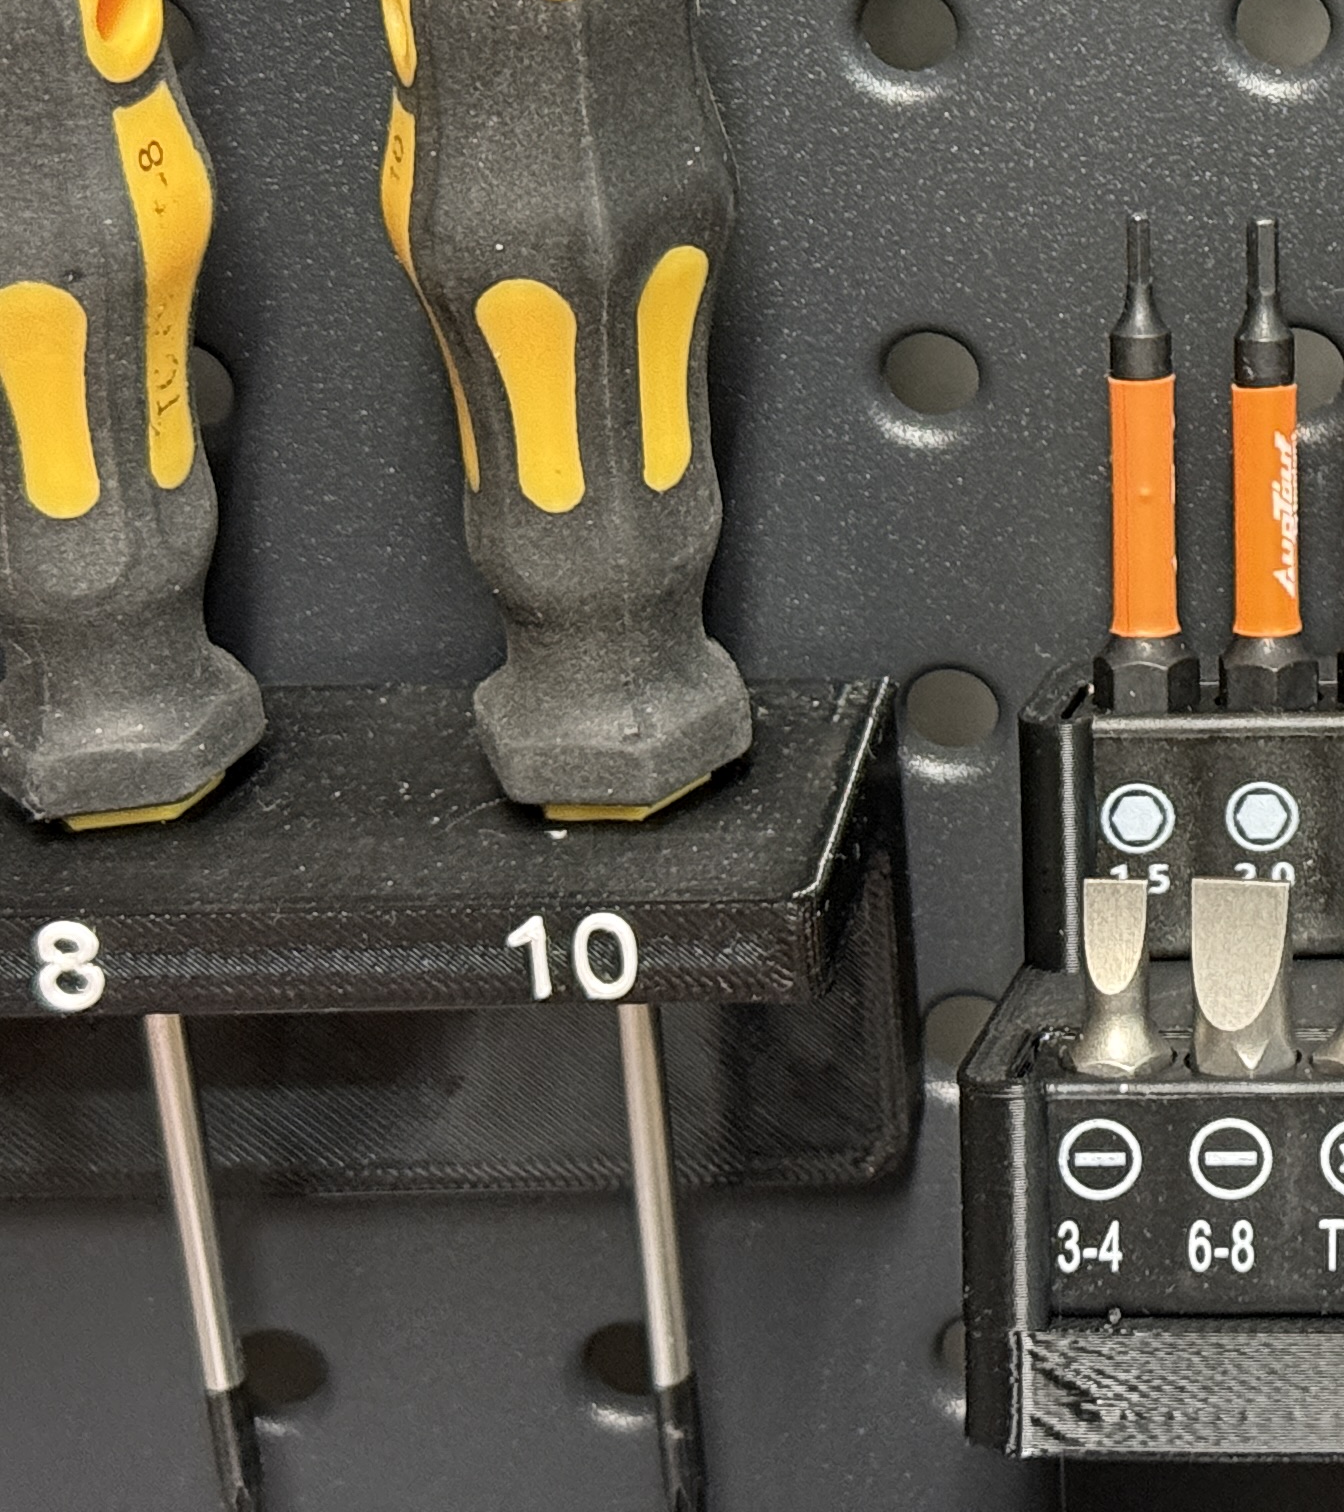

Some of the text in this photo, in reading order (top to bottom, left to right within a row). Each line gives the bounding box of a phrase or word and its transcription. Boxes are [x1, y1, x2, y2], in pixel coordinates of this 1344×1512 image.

[36, 912, 638, 1011] 8 10
[1057, 1220, 1123, 1273] 3-4
[1188, 1219, 1255, 1273] 6-8
